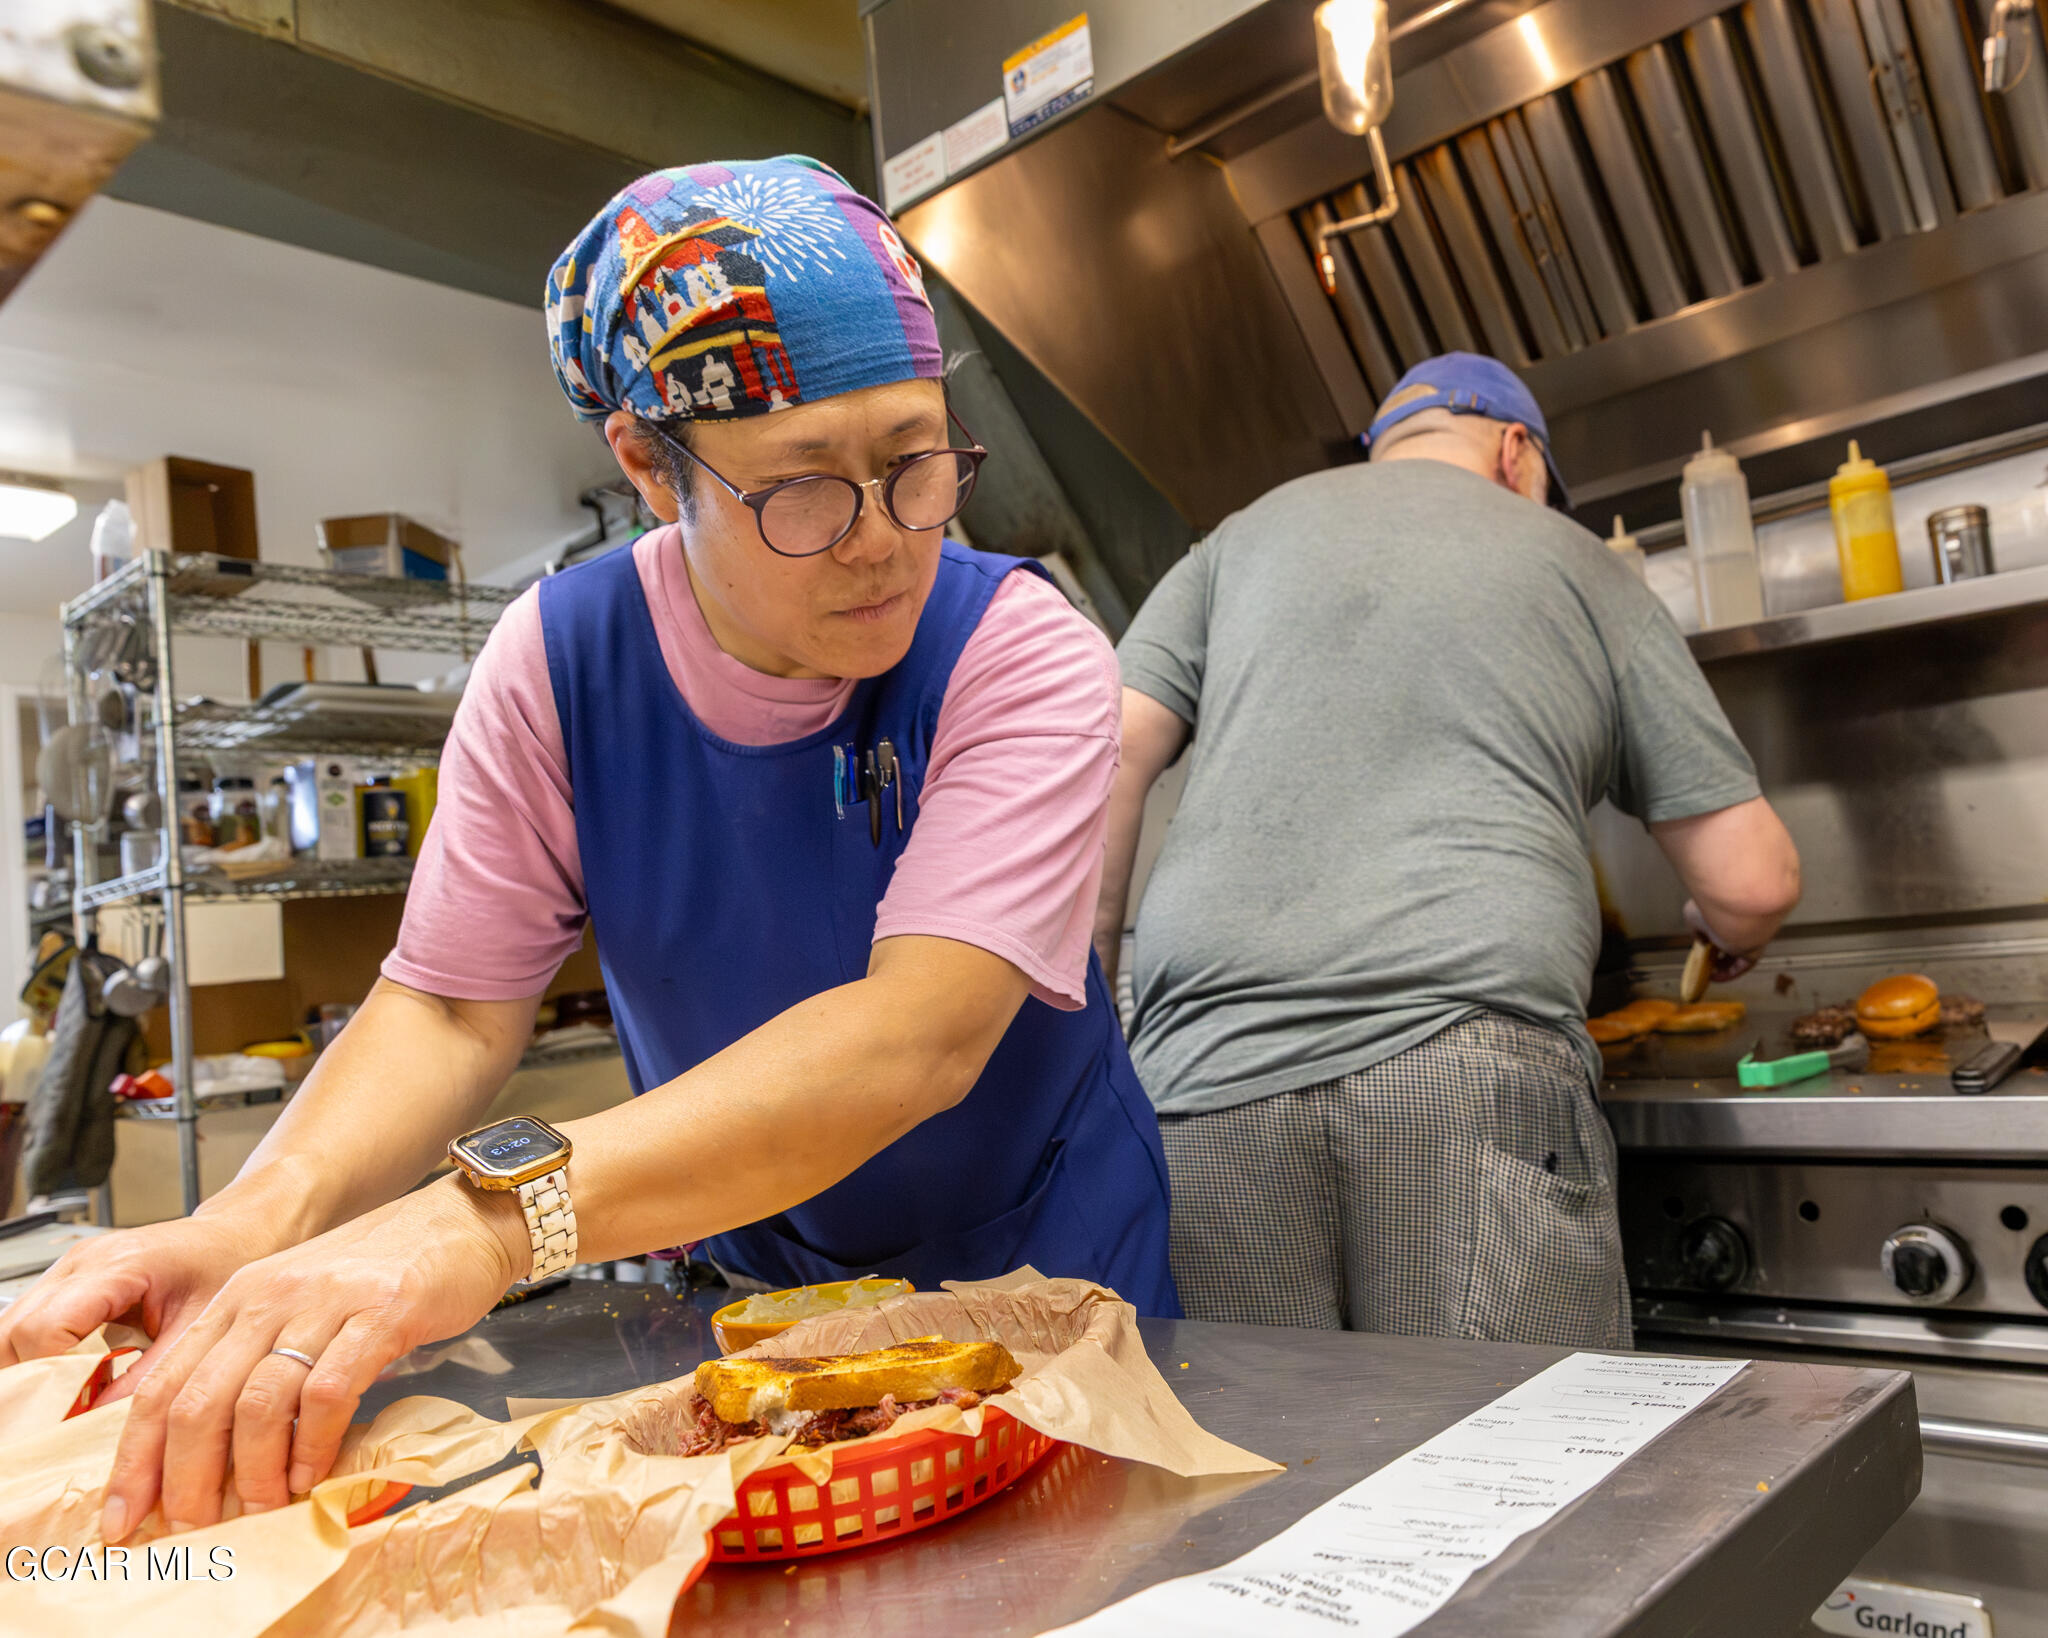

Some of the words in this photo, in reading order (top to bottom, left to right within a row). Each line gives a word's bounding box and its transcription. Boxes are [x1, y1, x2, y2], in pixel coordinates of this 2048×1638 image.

[490, 1137, 531, 1156] 02:13
[1644, 1402, 1686, 1410] Guest
[1551, 1412, 1587, 1422] Burger
[1588, 1416, 1630, 1426] Cheese
[1568, 1434, 1606, 1444] Burger
[1564, 1446, 1576, 1454] 3
[1577, 1448, 1624, 1458] Guest
[1508, 1500, 1557, 1508] Guest
[1242, 1576, 1293, 1598] Room
[1280, 1573, 1342, 1598] Dine-In
[1855, 1606, 1967, 1638] Garland
